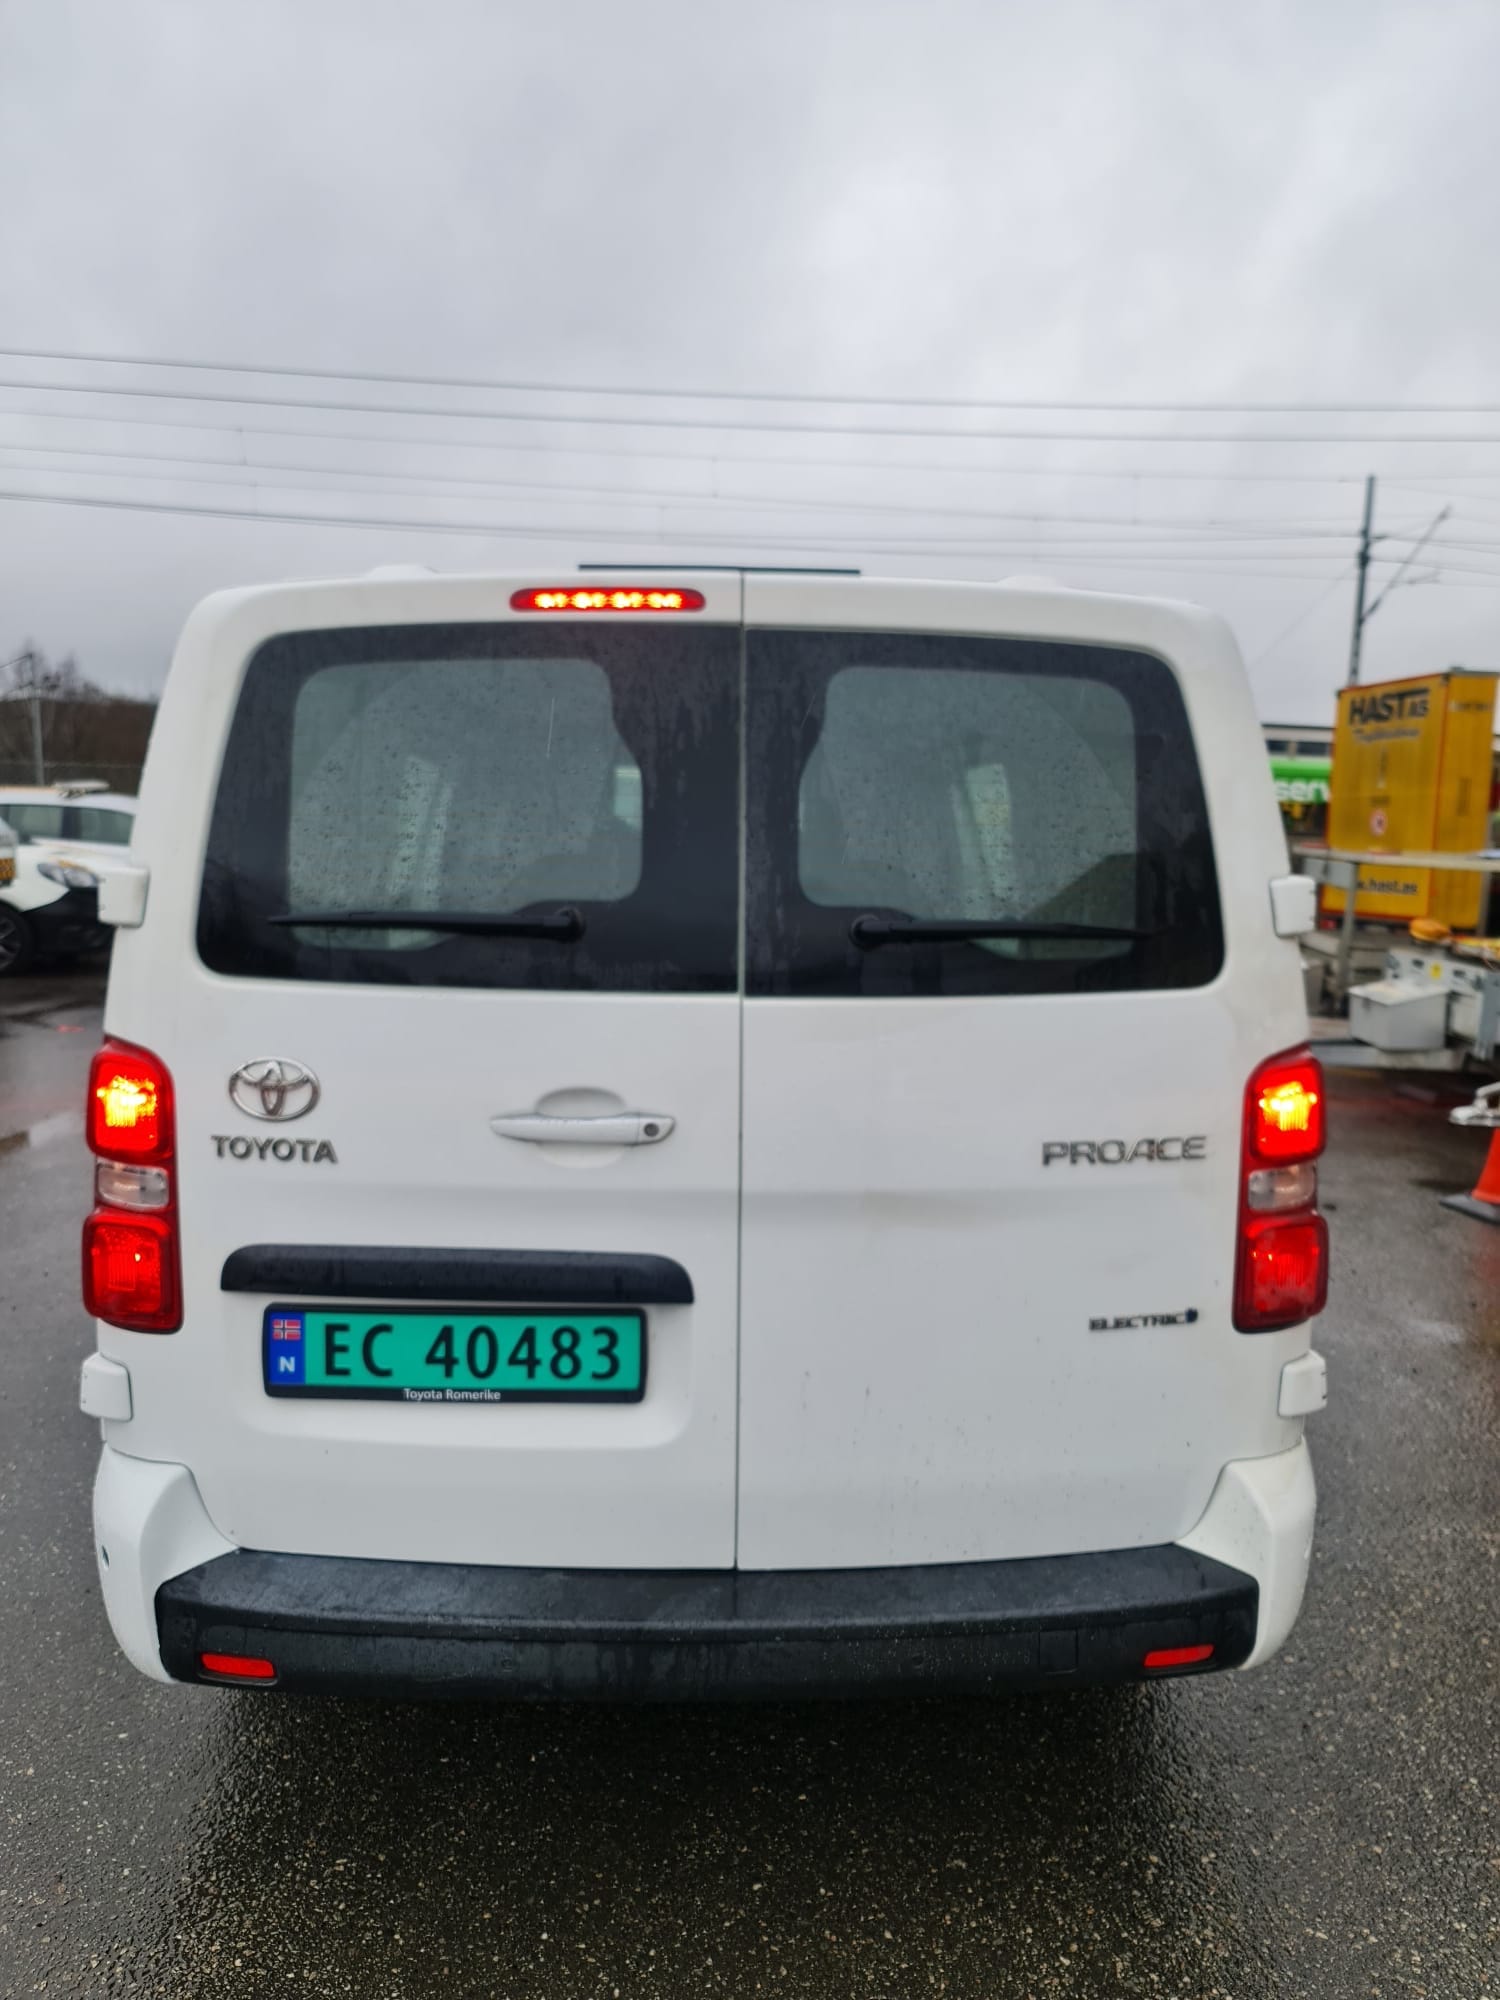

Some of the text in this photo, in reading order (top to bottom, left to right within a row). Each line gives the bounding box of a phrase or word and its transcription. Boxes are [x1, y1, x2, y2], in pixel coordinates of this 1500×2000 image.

[1349, 689, 1429, 725] HAST
[211, 1135, 338, 1164] TOYOTA
[1042, 1136, 1207, 1167] PROACE
[1089, 1313, 1186, 1331] ELECTRIC
[279, 1356, 295, 1373] N
[324, 1323, 621, 1381] EC 40483
[404, 1388, 501, 1402] Toyota Romerike
